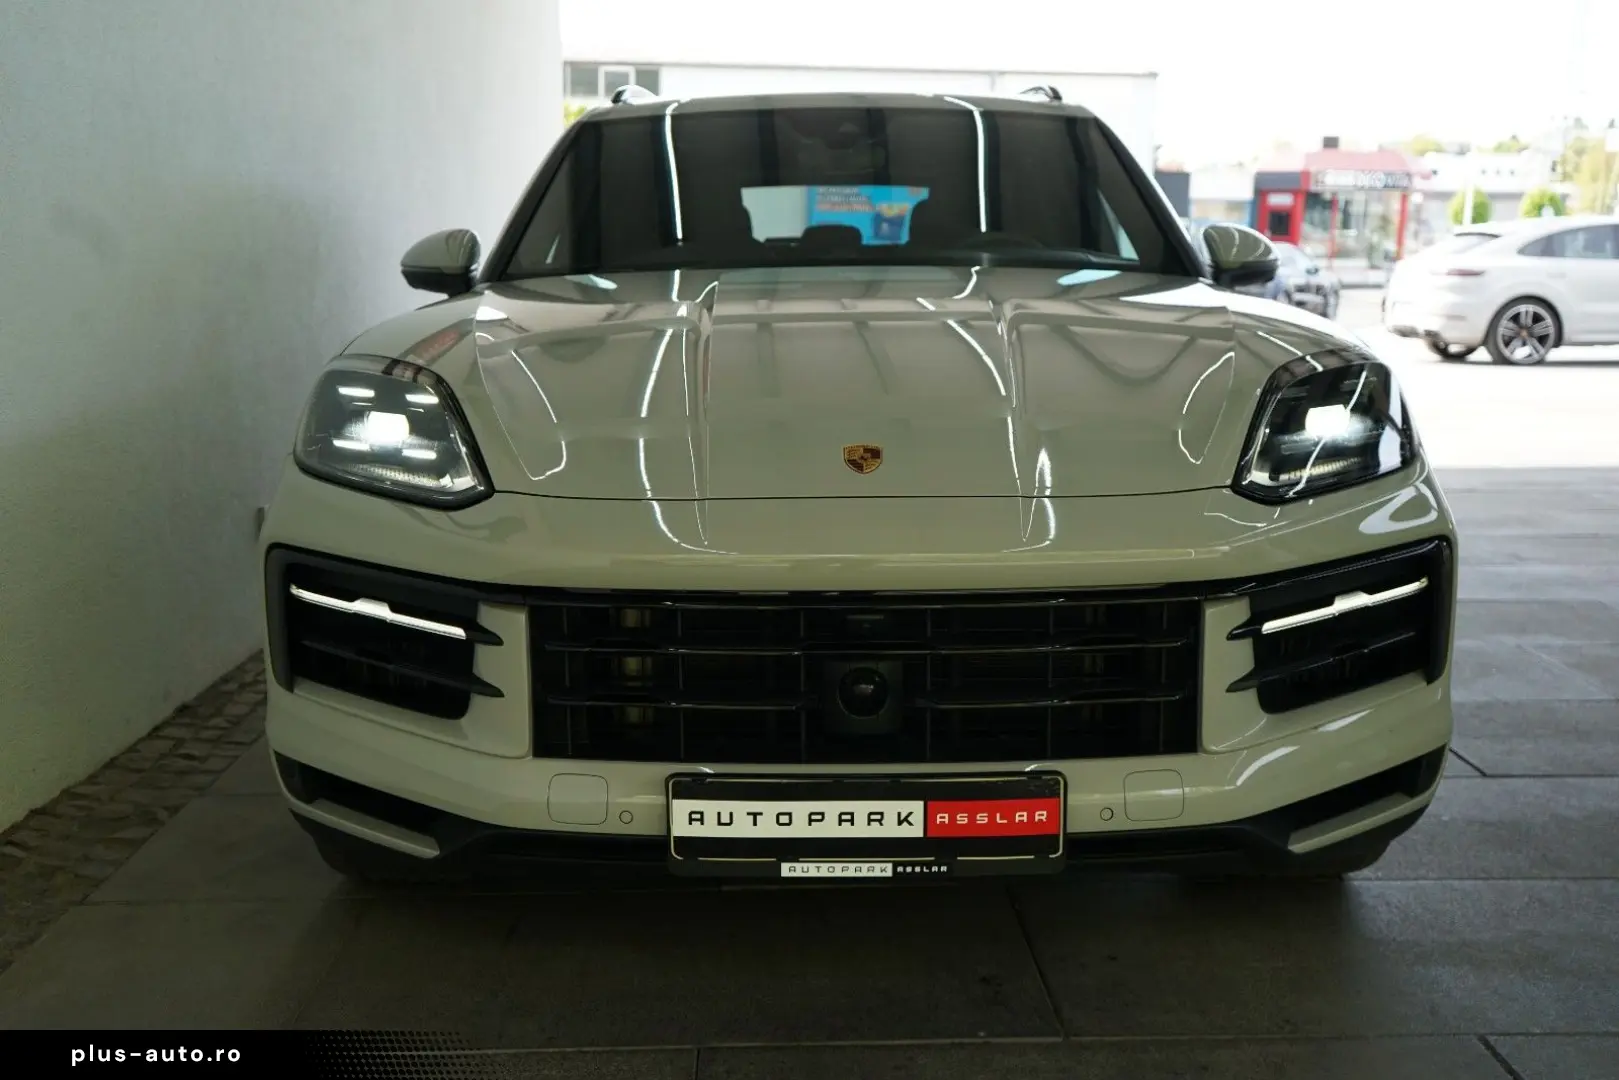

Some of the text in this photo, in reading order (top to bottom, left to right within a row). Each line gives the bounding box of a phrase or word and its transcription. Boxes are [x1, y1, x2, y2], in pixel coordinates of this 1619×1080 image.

[688, 810, 1048, 827] AUTOPARK ASSLAR
[788, 865, 948, 874] AUTOPARK ASSLAR
